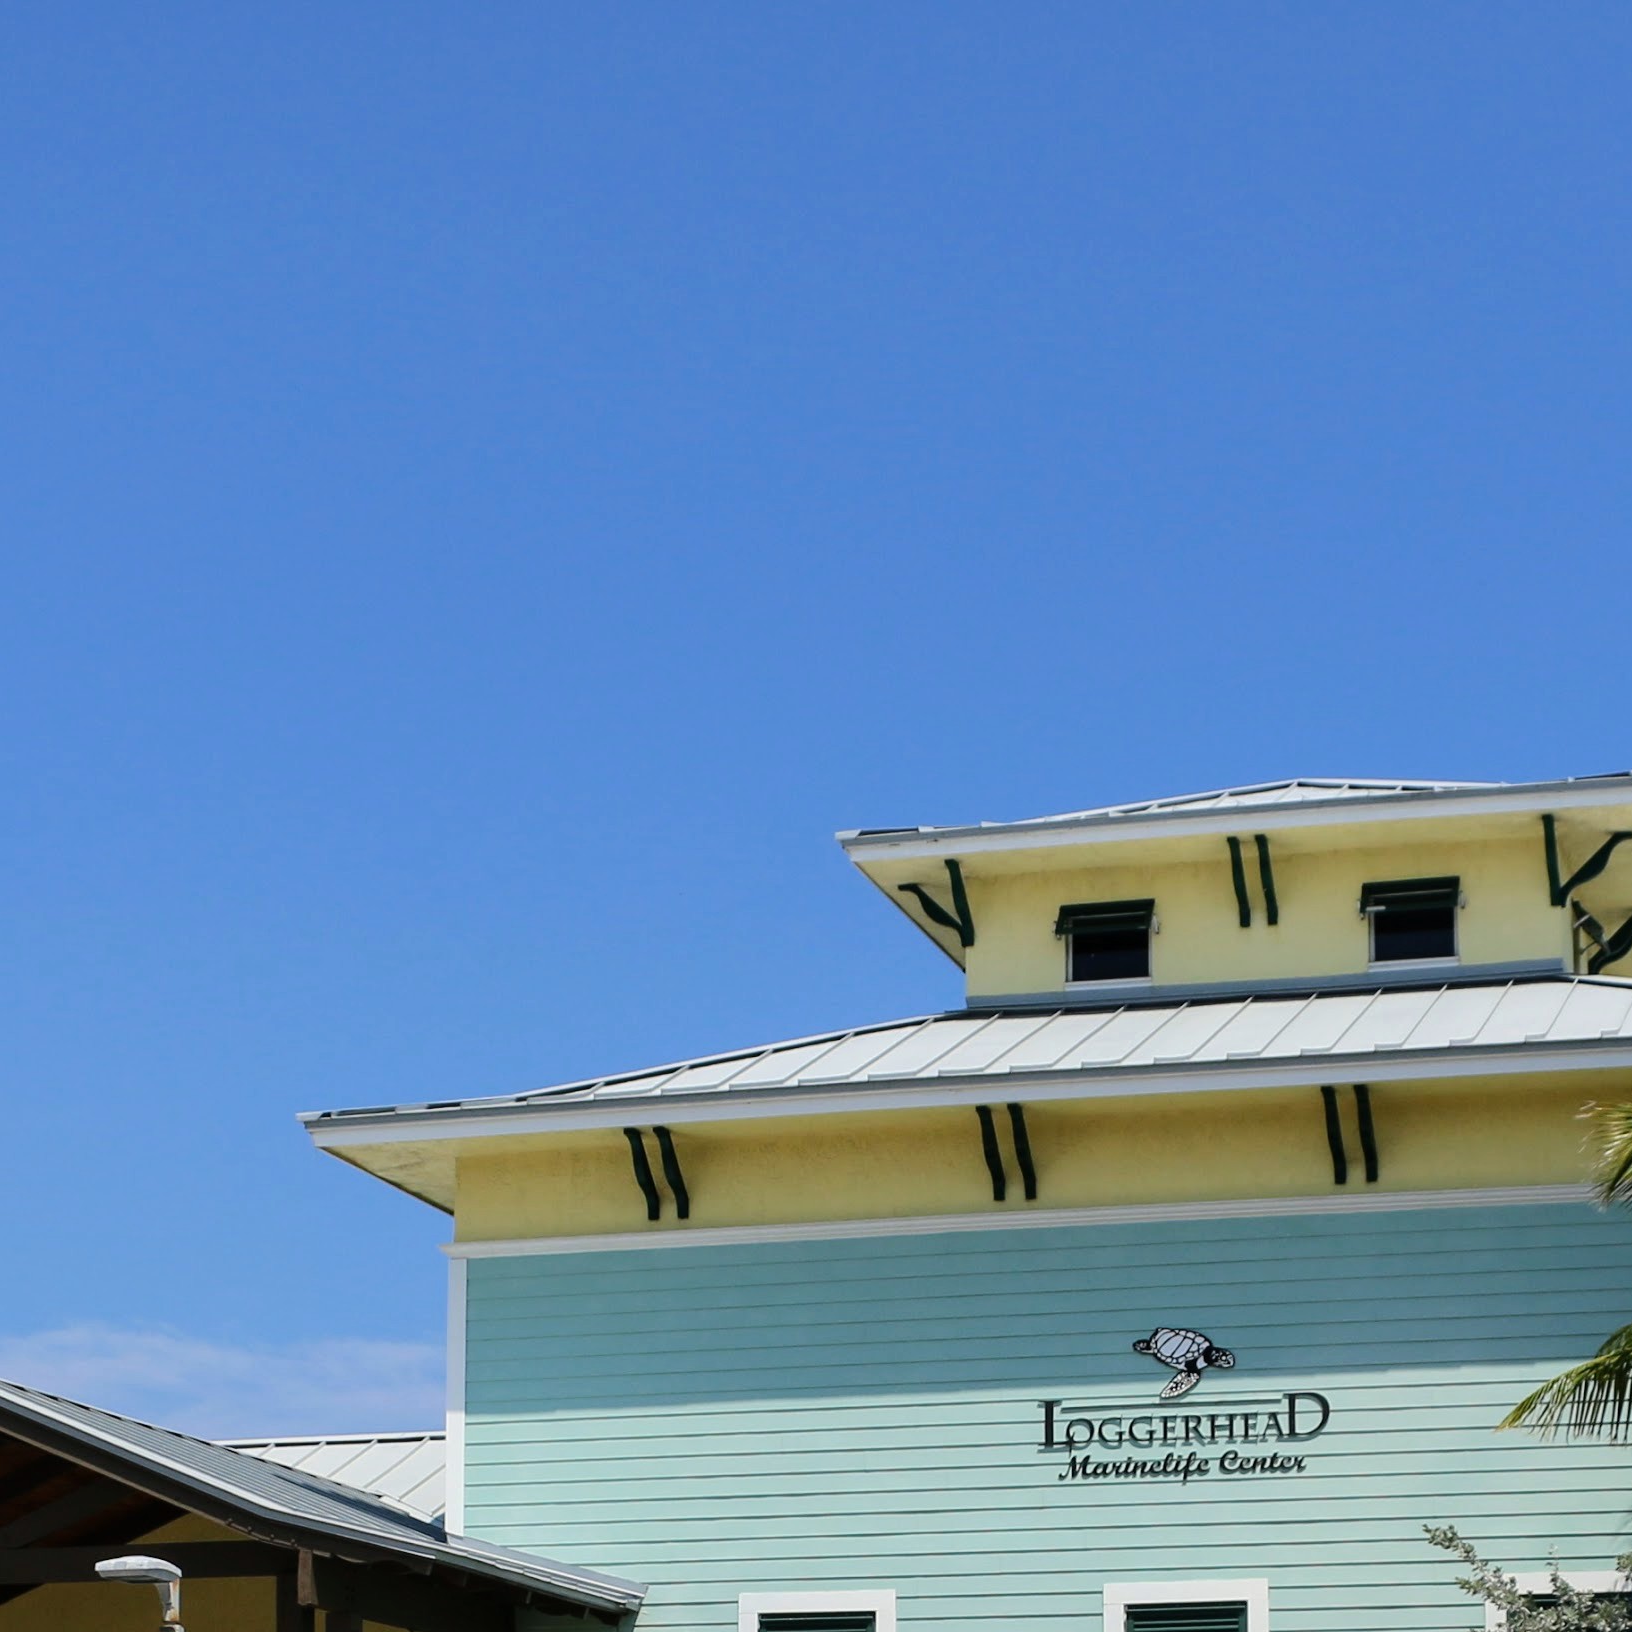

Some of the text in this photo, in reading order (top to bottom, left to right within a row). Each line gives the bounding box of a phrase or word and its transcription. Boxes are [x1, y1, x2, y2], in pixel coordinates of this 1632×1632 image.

[1037, 1391, 1330, 1456] LOGGERHEAD
[1058, 1450, 1307, 1485] Marinelife Center
